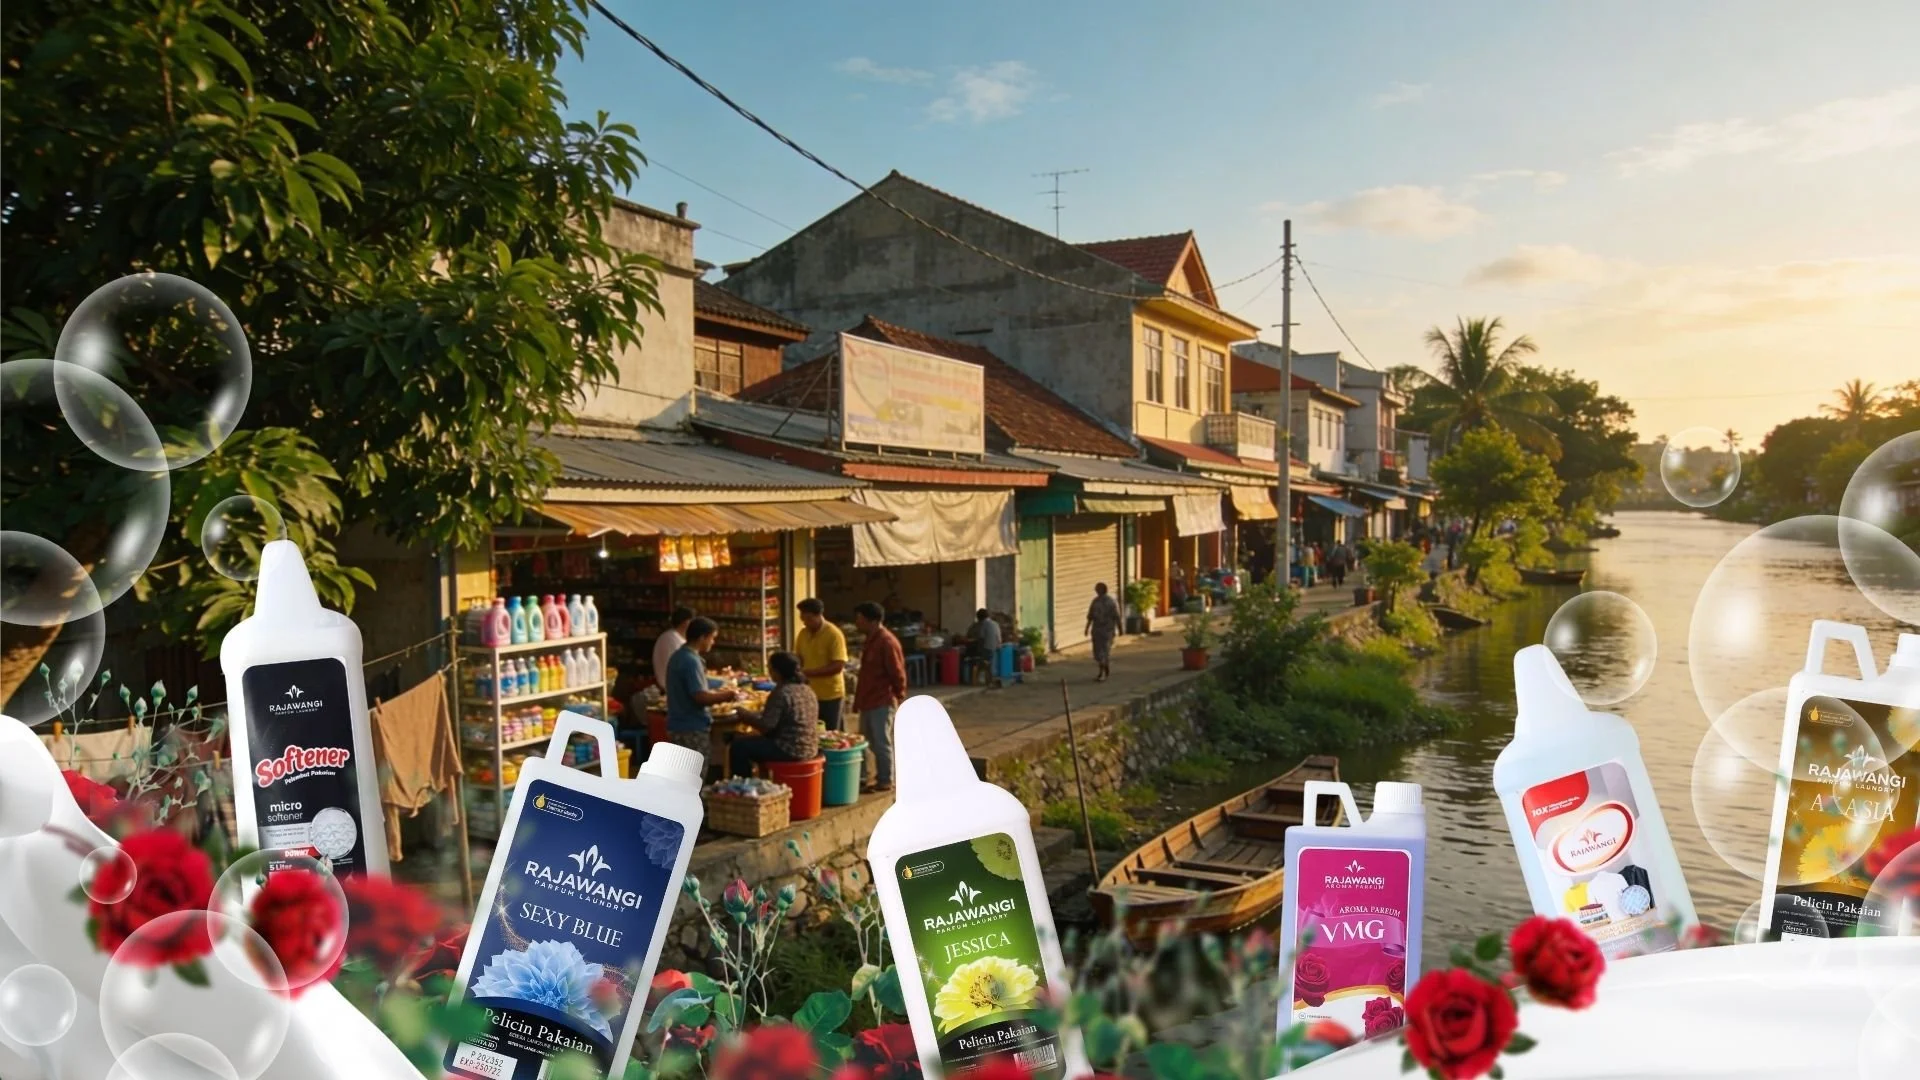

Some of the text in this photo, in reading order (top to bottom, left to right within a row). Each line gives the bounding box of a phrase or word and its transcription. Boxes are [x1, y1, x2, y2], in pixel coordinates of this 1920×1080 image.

[269, 700, 323, 712] RAJAWANGI
[255, 745, 350, 788] Softener
[1808, 763, 1906, 788] RAJAWANGI
[1855, 783, 1895, 793] LAUNDRY
[267, 812, 303, 822] softener
[270, 801, 302, 812] micro
[1532, 806, 1549, 817] 10X
[1810, 793, 1895, 821] AASIA
[1570, 837, 1617, 857] RAJAWANGI
[524, 860, 643, 909] RAJAWANGI
[1325, 875, 1384, 885] RAJAWANGI
[534, 879, 625, 913] PARFUM LAUNDRY
[1793, 895, 1833, 910] Pelicin
[1837, 901, 1881, 917] Pakaian
[924, 898, 1015, 930] RAJAWANGI
[936, 913, 1008, 934] PARFUM LAUNDRY
[1340, 906, 1401, 917] AROMA PARFUM
[519, 902, 624, 948] SEXY BLUE
[1321, 919, 1385, 943] VMG
[944, 931, 1012, 964] JESSICA
[483, 1007, 532, 1036] Pelicin
[537, 1025, 593, 1055] Pakaian
[958, 1034, 998, 1050] Pelicin
[997, 1024, 1038, 1041] Pakaian
